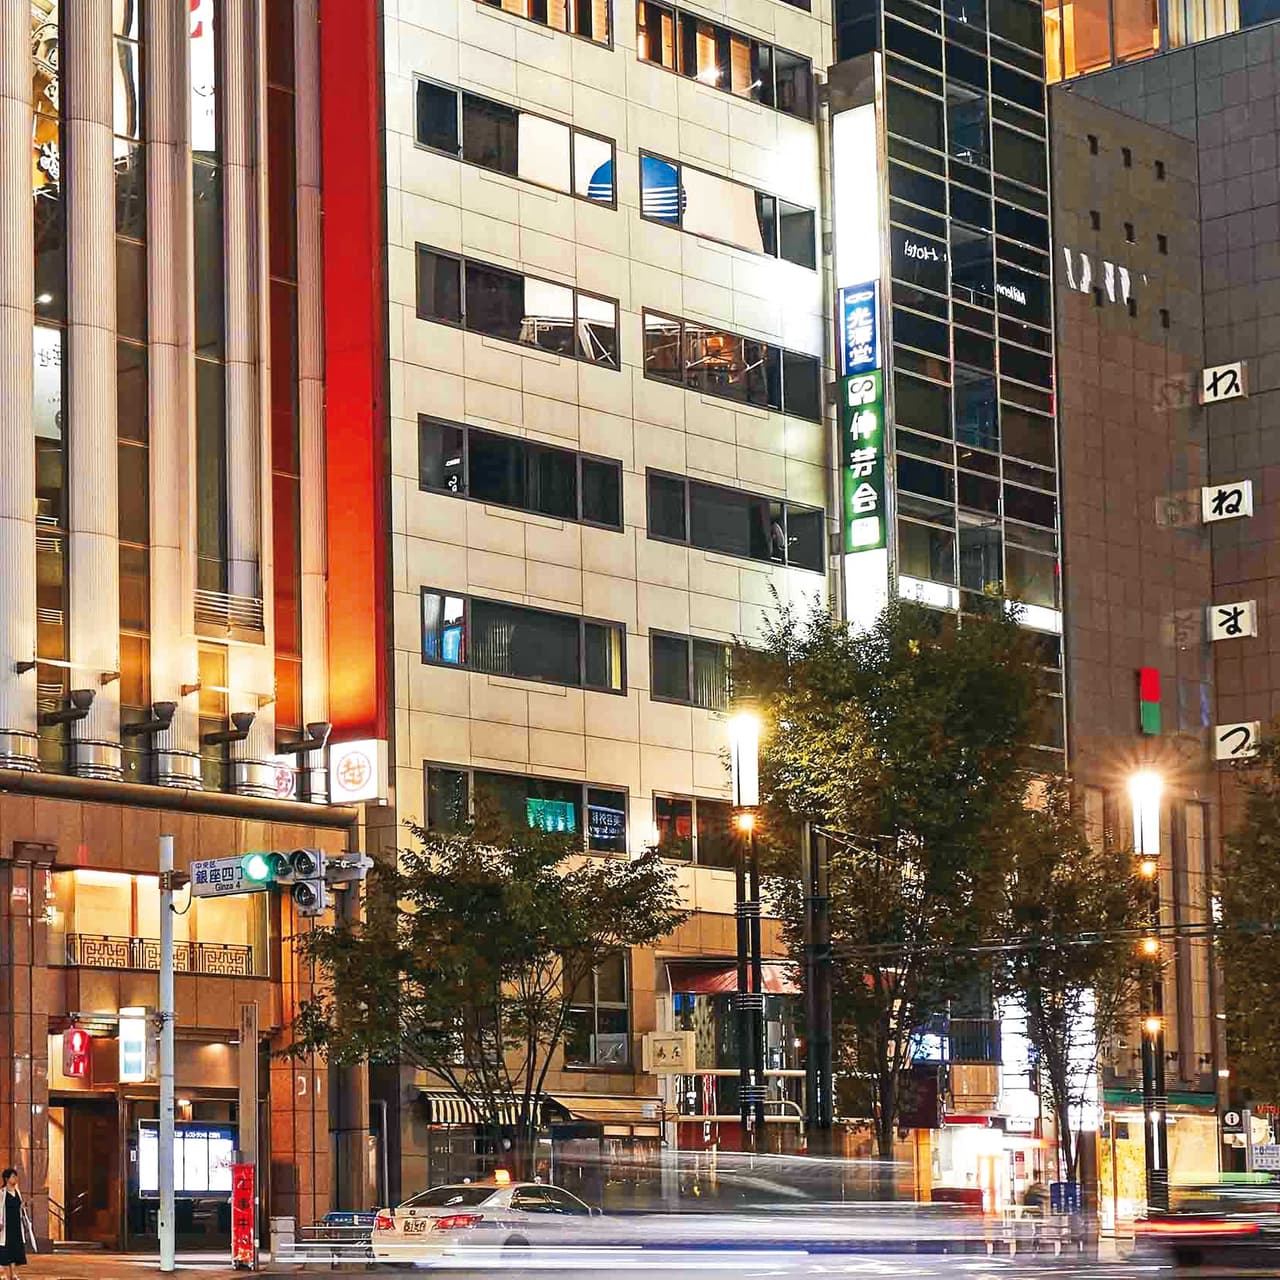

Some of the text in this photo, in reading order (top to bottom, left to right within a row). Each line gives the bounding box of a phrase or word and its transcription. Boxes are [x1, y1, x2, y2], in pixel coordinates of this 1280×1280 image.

[195, 865, 243, 885] 銀座四丁
[215, 882, 234, 891] Ginza
